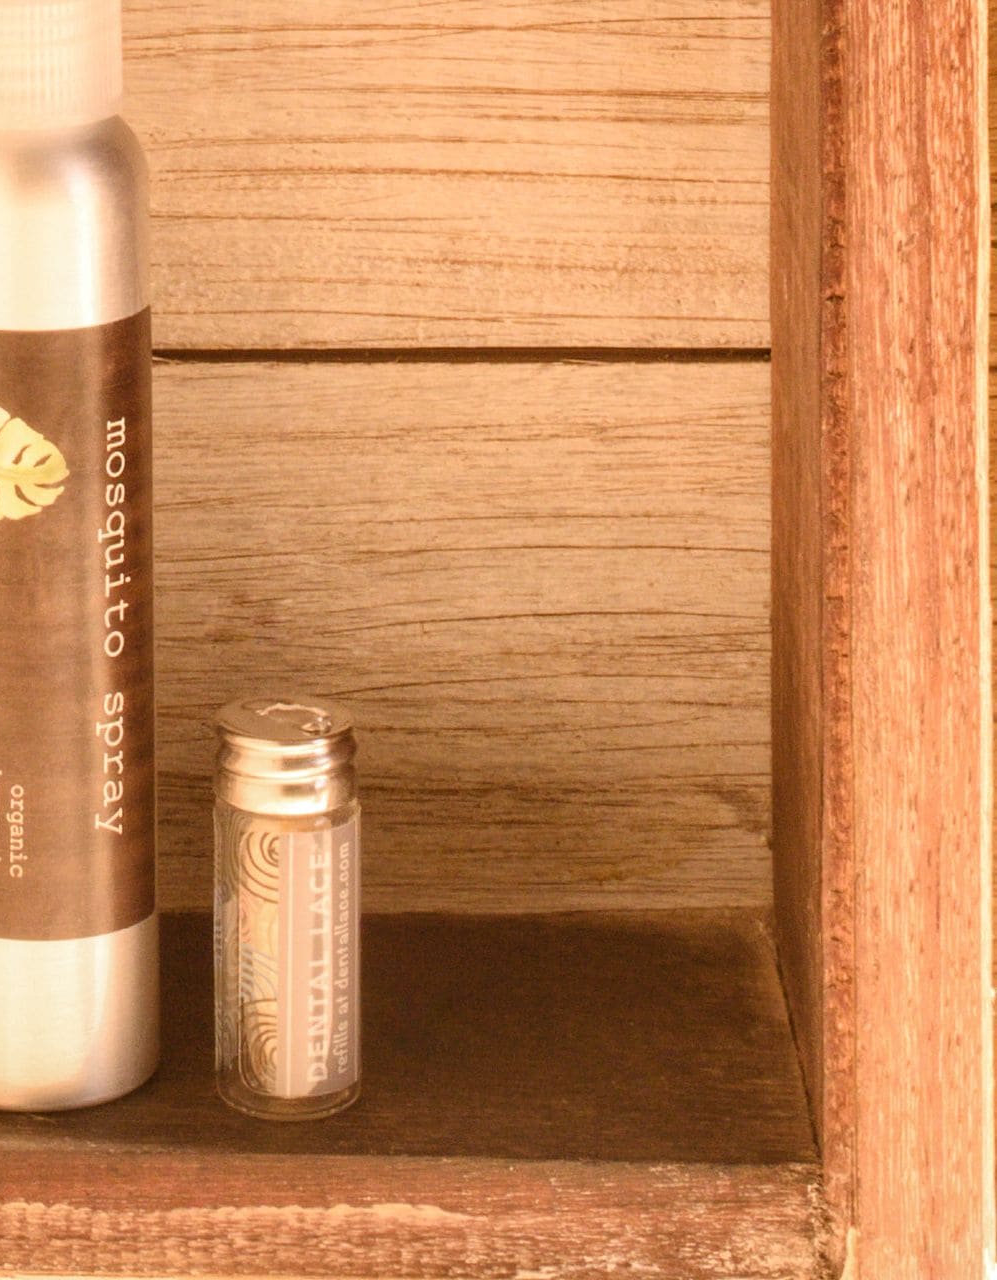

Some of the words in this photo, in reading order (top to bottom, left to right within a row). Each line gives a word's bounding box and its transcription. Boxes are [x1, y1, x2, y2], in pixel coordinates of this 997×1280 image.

[97, 417, 131, 658] mosquito
[94, 691, 124, 836] spray
[6, 784, 28, 878] organic
[310, 848, 330, 939] LACE
[334, 842, 350, 991] dentallace.com
[308, 959, 329, 1083] DENTAL
[332, 1020, 349, 1074] refills
[335, 995, 348, 1016] at
